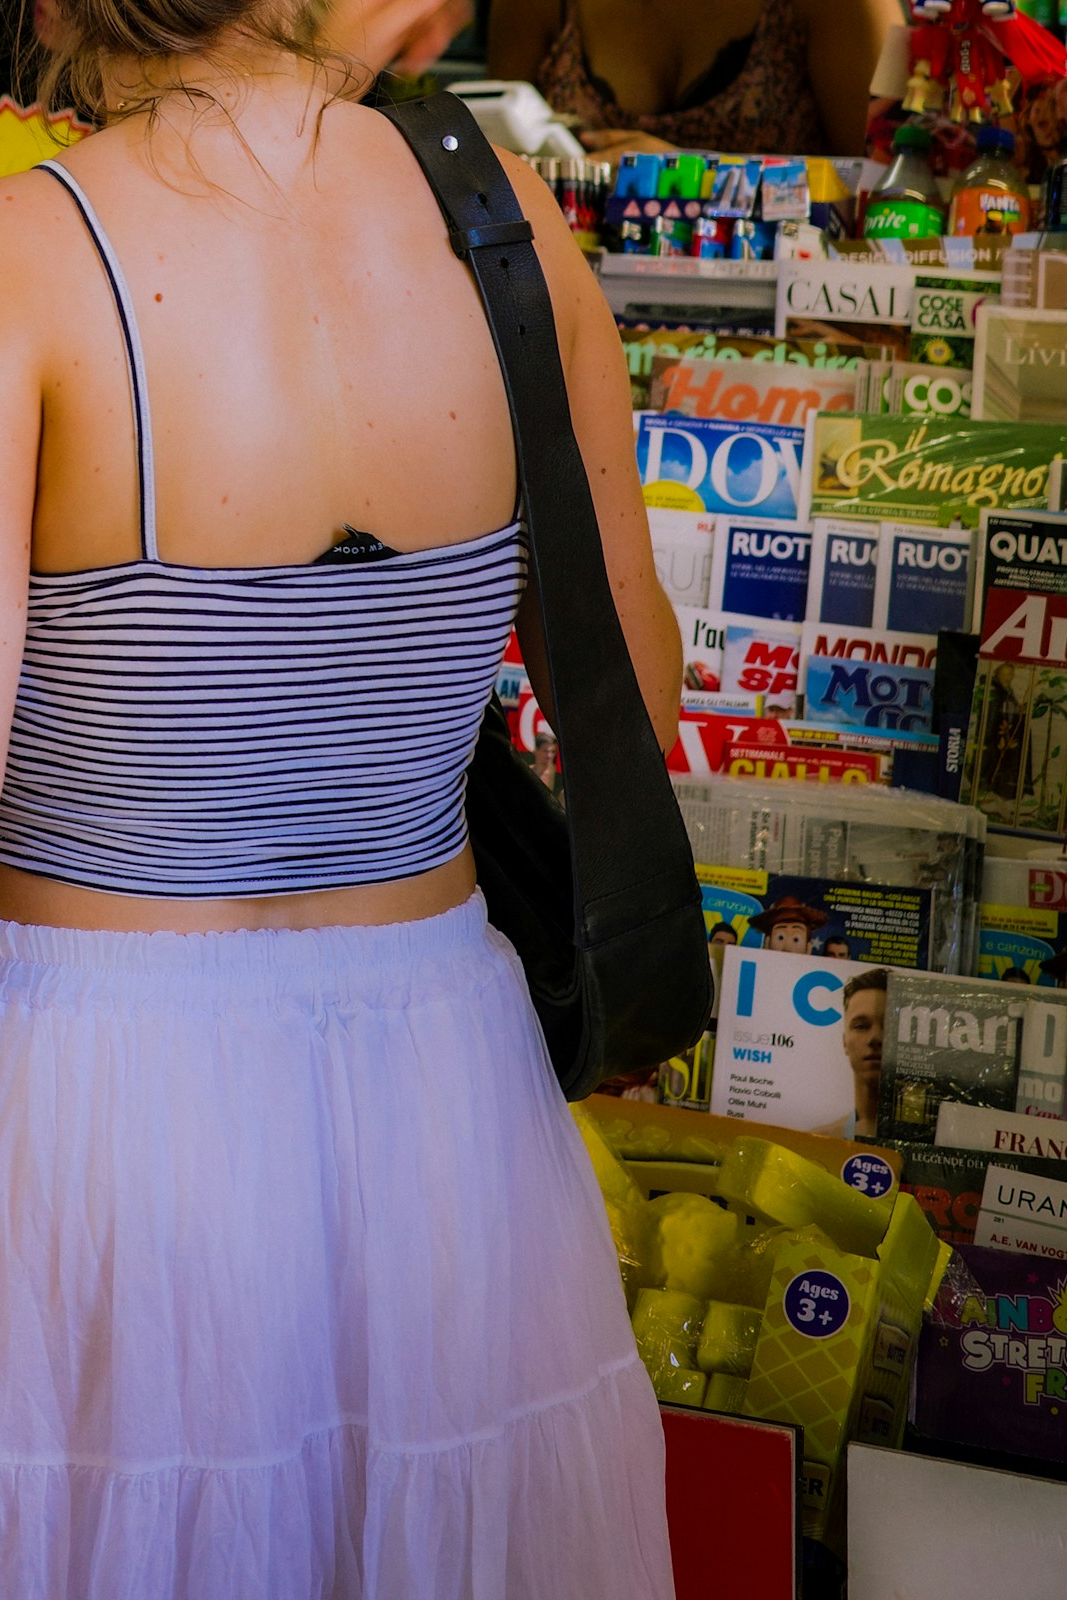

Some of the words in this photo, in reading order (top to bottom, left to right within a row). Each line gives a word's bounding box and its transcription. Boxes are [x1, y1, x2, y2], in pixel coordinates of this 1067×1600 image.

[918, 293, 964, 312] COSE
[917, 312, 966, 330] CASA
[333, 545, 367, 555] LOOK
[368, 541, 388, 553] EW
[729, 747, 786, 762] SETTIMANALE
[732, 1047, 773, 1065] WISH
[730, 1073, 748, 1086] Paul
[993, 1130, 1067, 1163] FRAN
[850, 1157, 889, 1176] Ages
[910, 1152, 965, 1169] LEGGENDE
[990, 1232, 1011, 1247] A.E.
[1015, 1238, 1038, 1253] VAN
[797, 1279, 840, 1301] Ages
[796, 1297, 834, 1327] 3+
